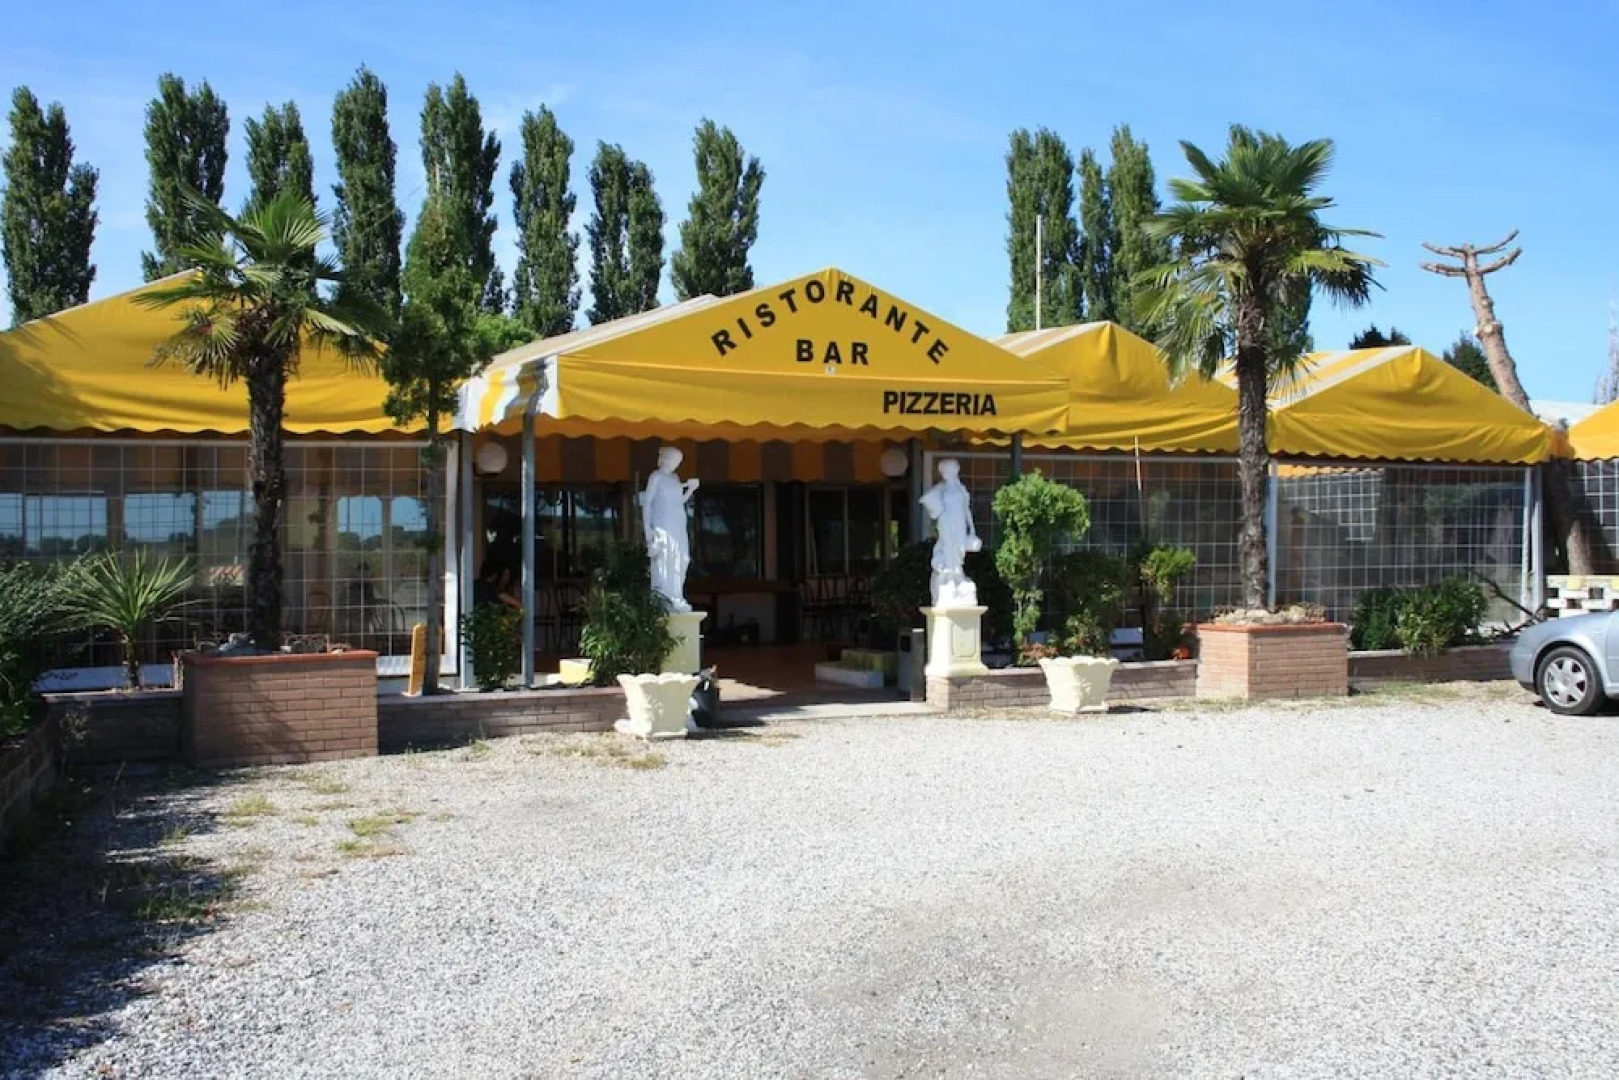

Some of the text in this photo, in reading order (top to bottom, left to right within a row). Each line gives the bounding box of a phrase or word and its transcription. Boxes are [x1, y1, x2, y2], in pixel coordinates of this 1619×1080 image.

[711, 280, 949, 364] RISTORANTE
[796, 339, 869, 365] BAR
[883, 391, 997, 416] PIZZERIA
